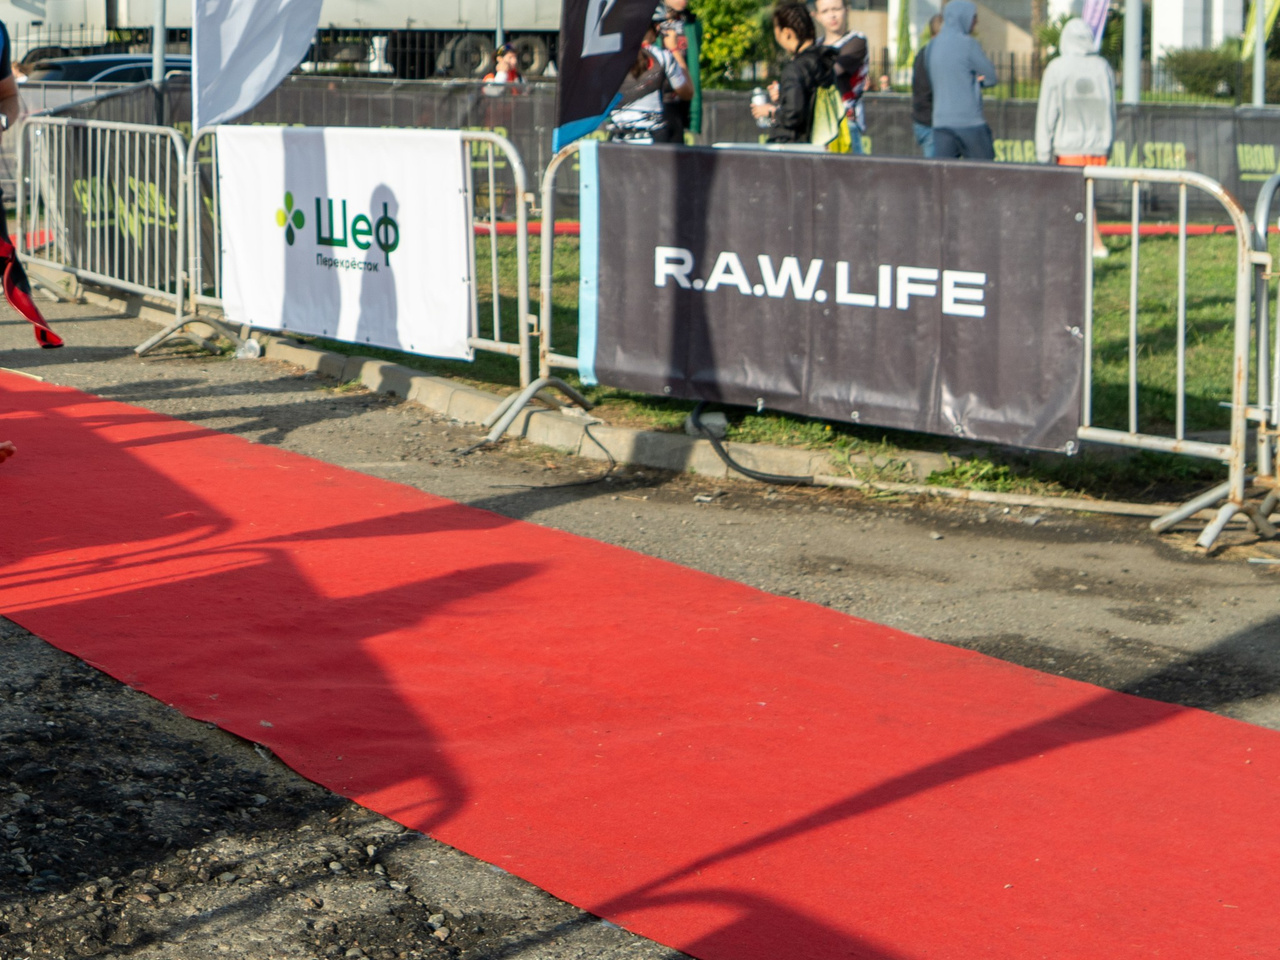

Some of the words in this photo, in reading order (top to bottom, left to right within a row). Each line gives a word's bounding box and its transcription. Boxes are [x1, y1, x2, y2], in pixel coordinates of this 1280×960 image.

[1142, 141, 1187, 169] STAR
[1236, 143, 1276, 172] IRON
[315, 196, 400, 266] Шеф
[653, 245, 987, 318] R.A.W.LIFE
